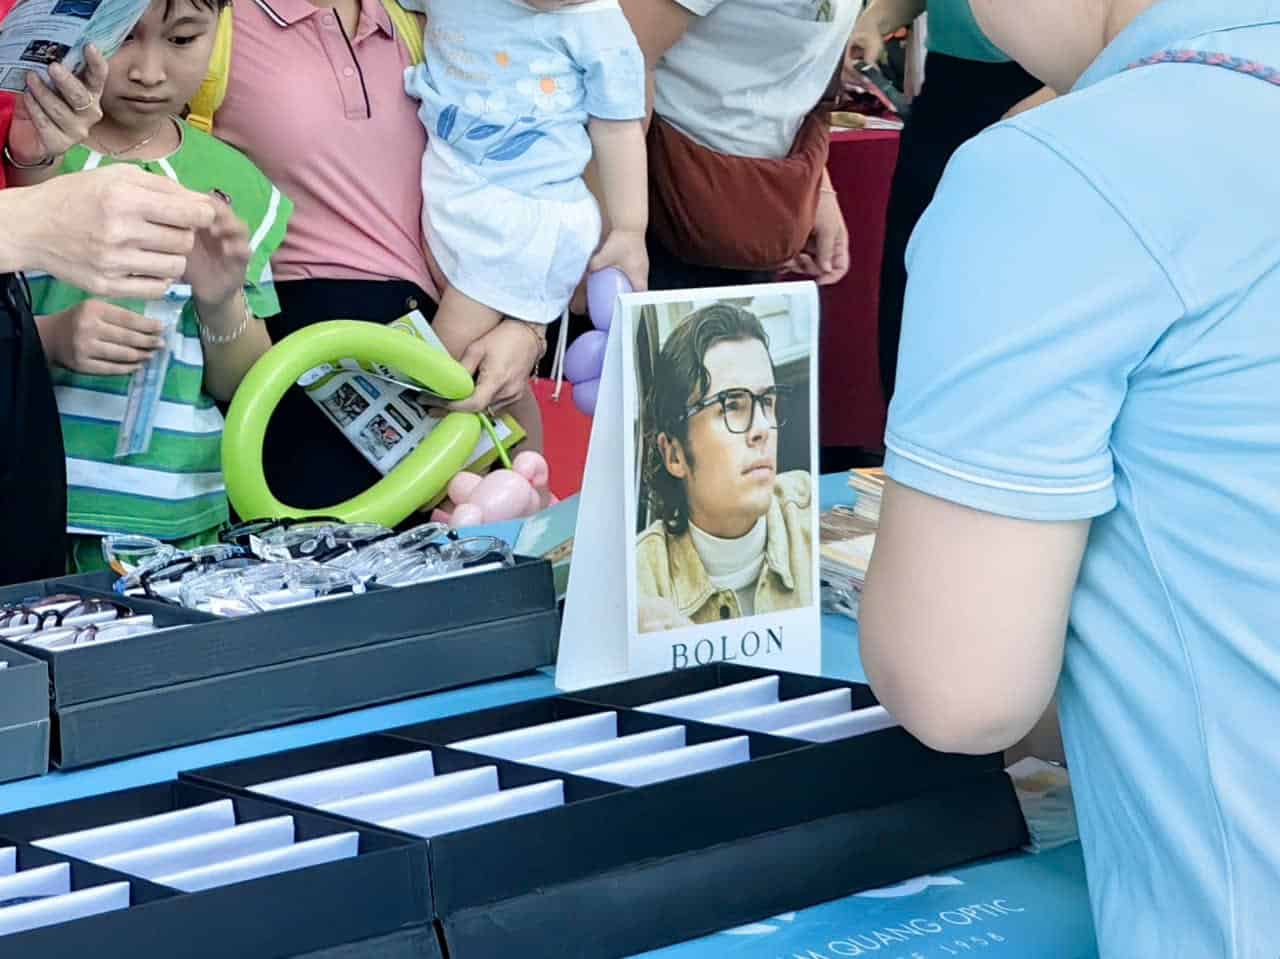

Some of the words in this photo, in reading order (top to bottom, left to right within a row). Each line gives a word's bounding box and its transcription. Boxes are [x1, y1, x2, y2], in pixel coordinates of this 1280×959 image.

[671, 626, 784, 670] BOLON
[827, 918, 943, 957] QUANG
[939, 898, 1025, 926] OPTIC
